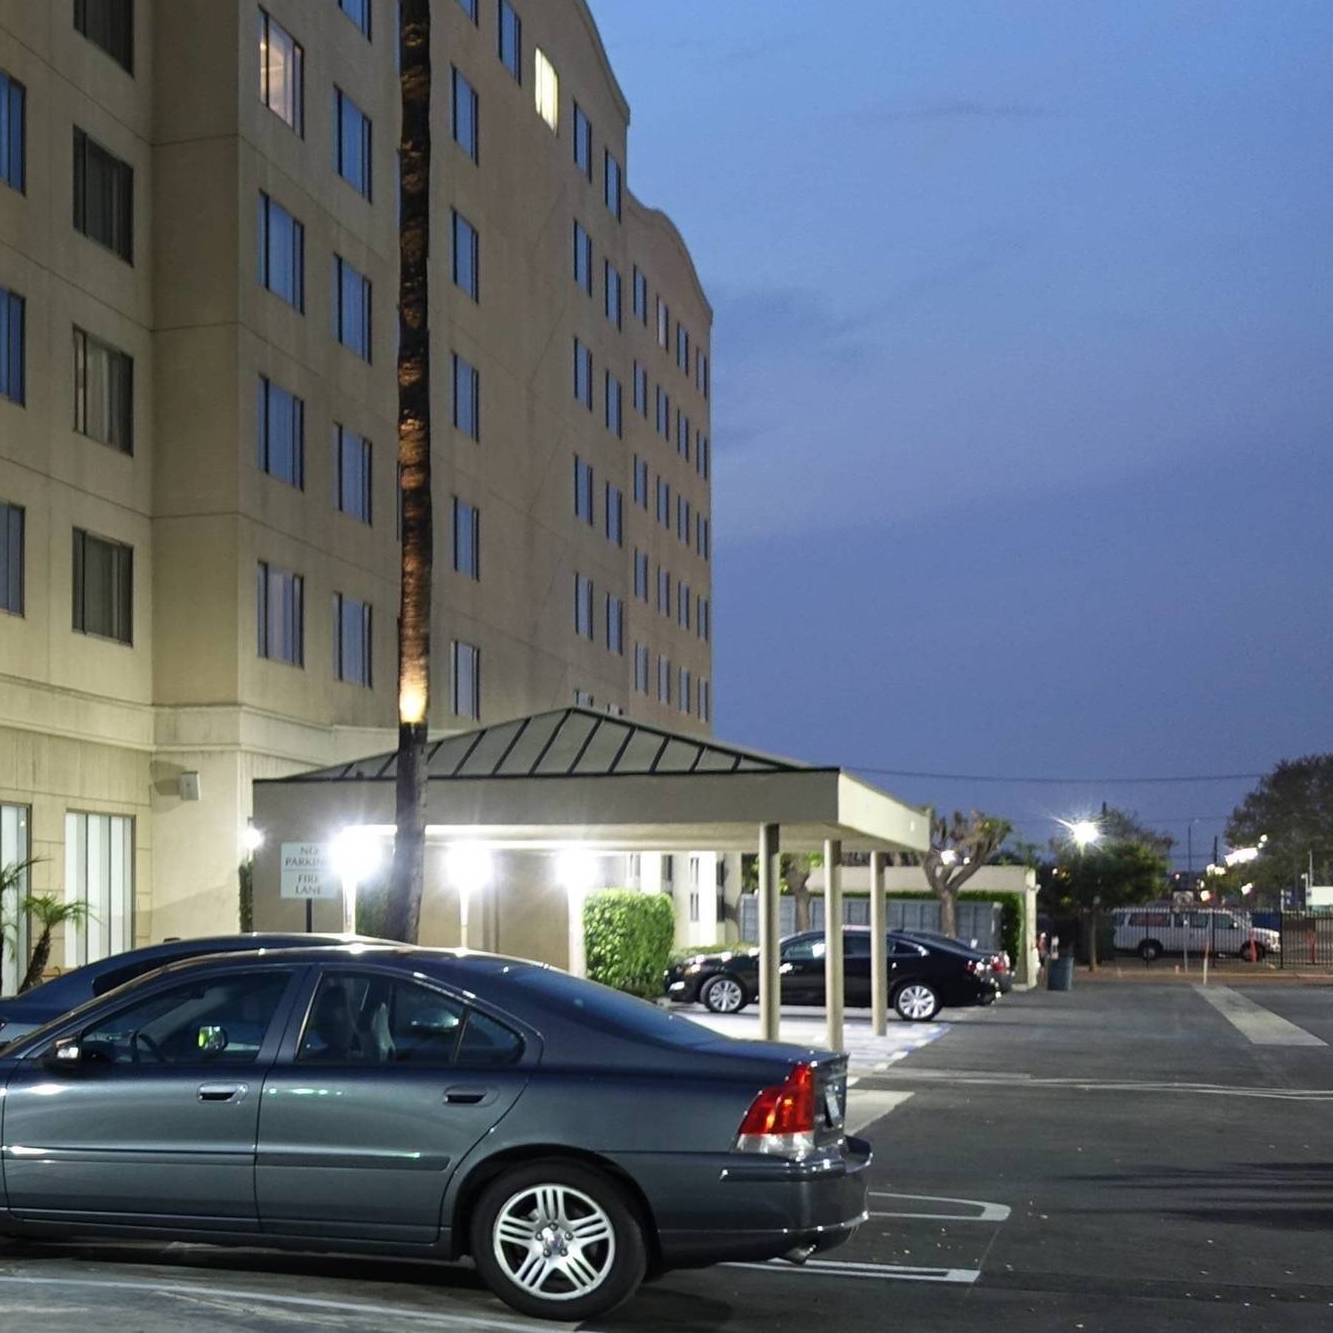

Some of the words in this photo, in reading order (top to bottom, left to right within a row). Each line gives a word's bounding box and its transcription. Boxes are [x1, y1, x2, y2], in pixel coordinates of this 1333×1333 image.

[300, 846, 318, 855] NO
[284, 857, 331, 867] PARKIN
[297, 873, 319, 884] FIRE
[295, 885, 321, 896] LANE
